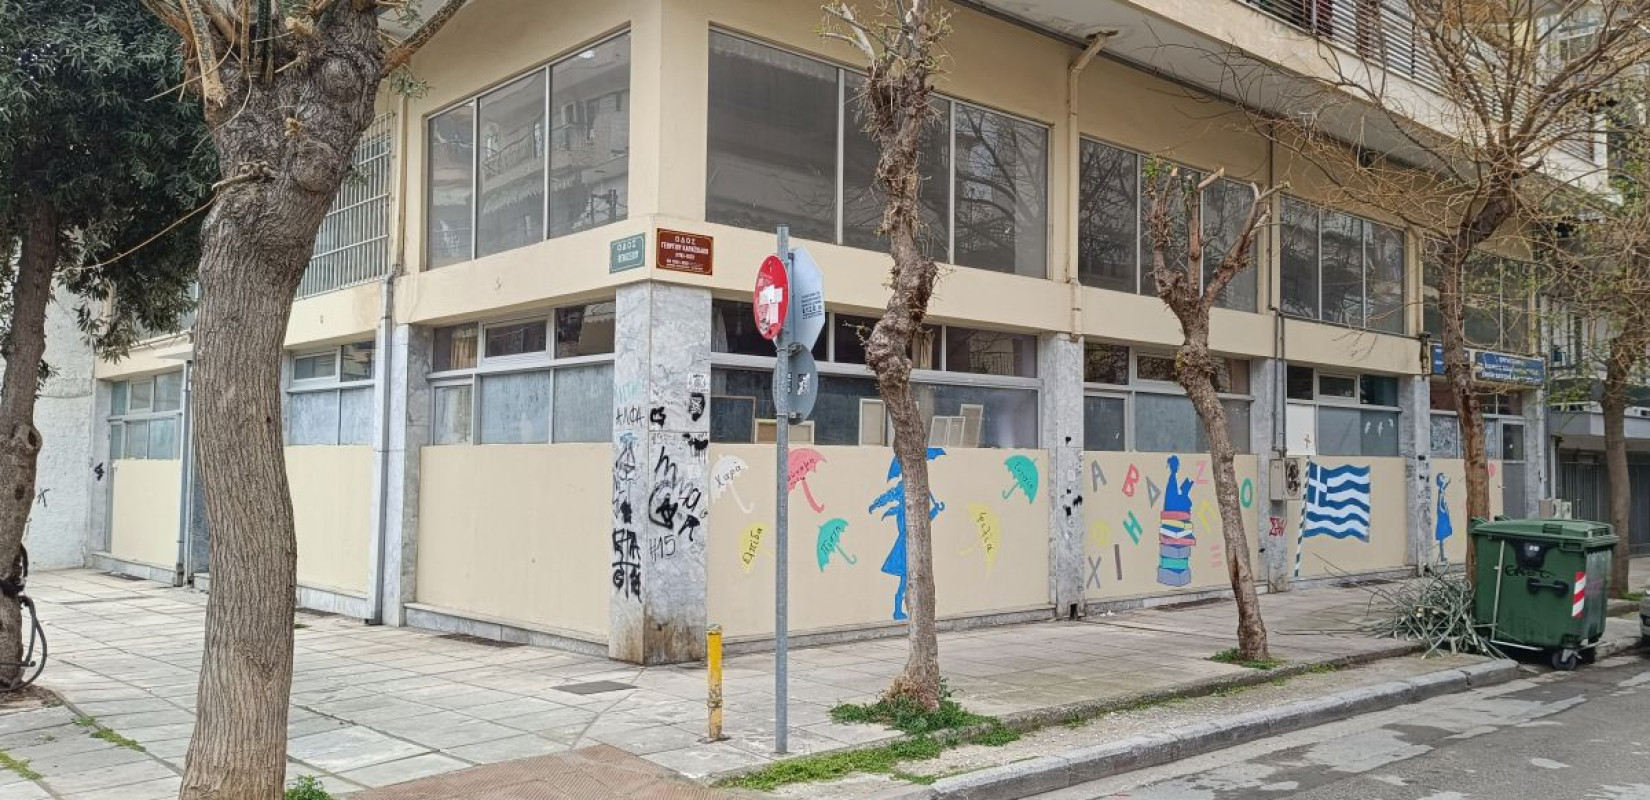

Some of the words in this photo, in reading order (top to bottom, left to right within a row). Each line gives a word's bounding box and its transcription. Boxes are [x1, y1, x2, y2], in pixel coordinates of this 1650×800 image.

[616, 240, 636, 251] ΟΔΟΣ
[675, 236, 696, 245] ΟΔΟΣ
[1091, 459, 1107, 492] Α
[1122, 463, 1140, 497] Β
[1196, 461, 1210, 484] Ζ
[1146, 475, 1162, 509] Δ
[1239, 477, 1254, 508] Ο
[1122, 510, 1143, 545] Η
[1086, 556, 1102, 589] Χ
